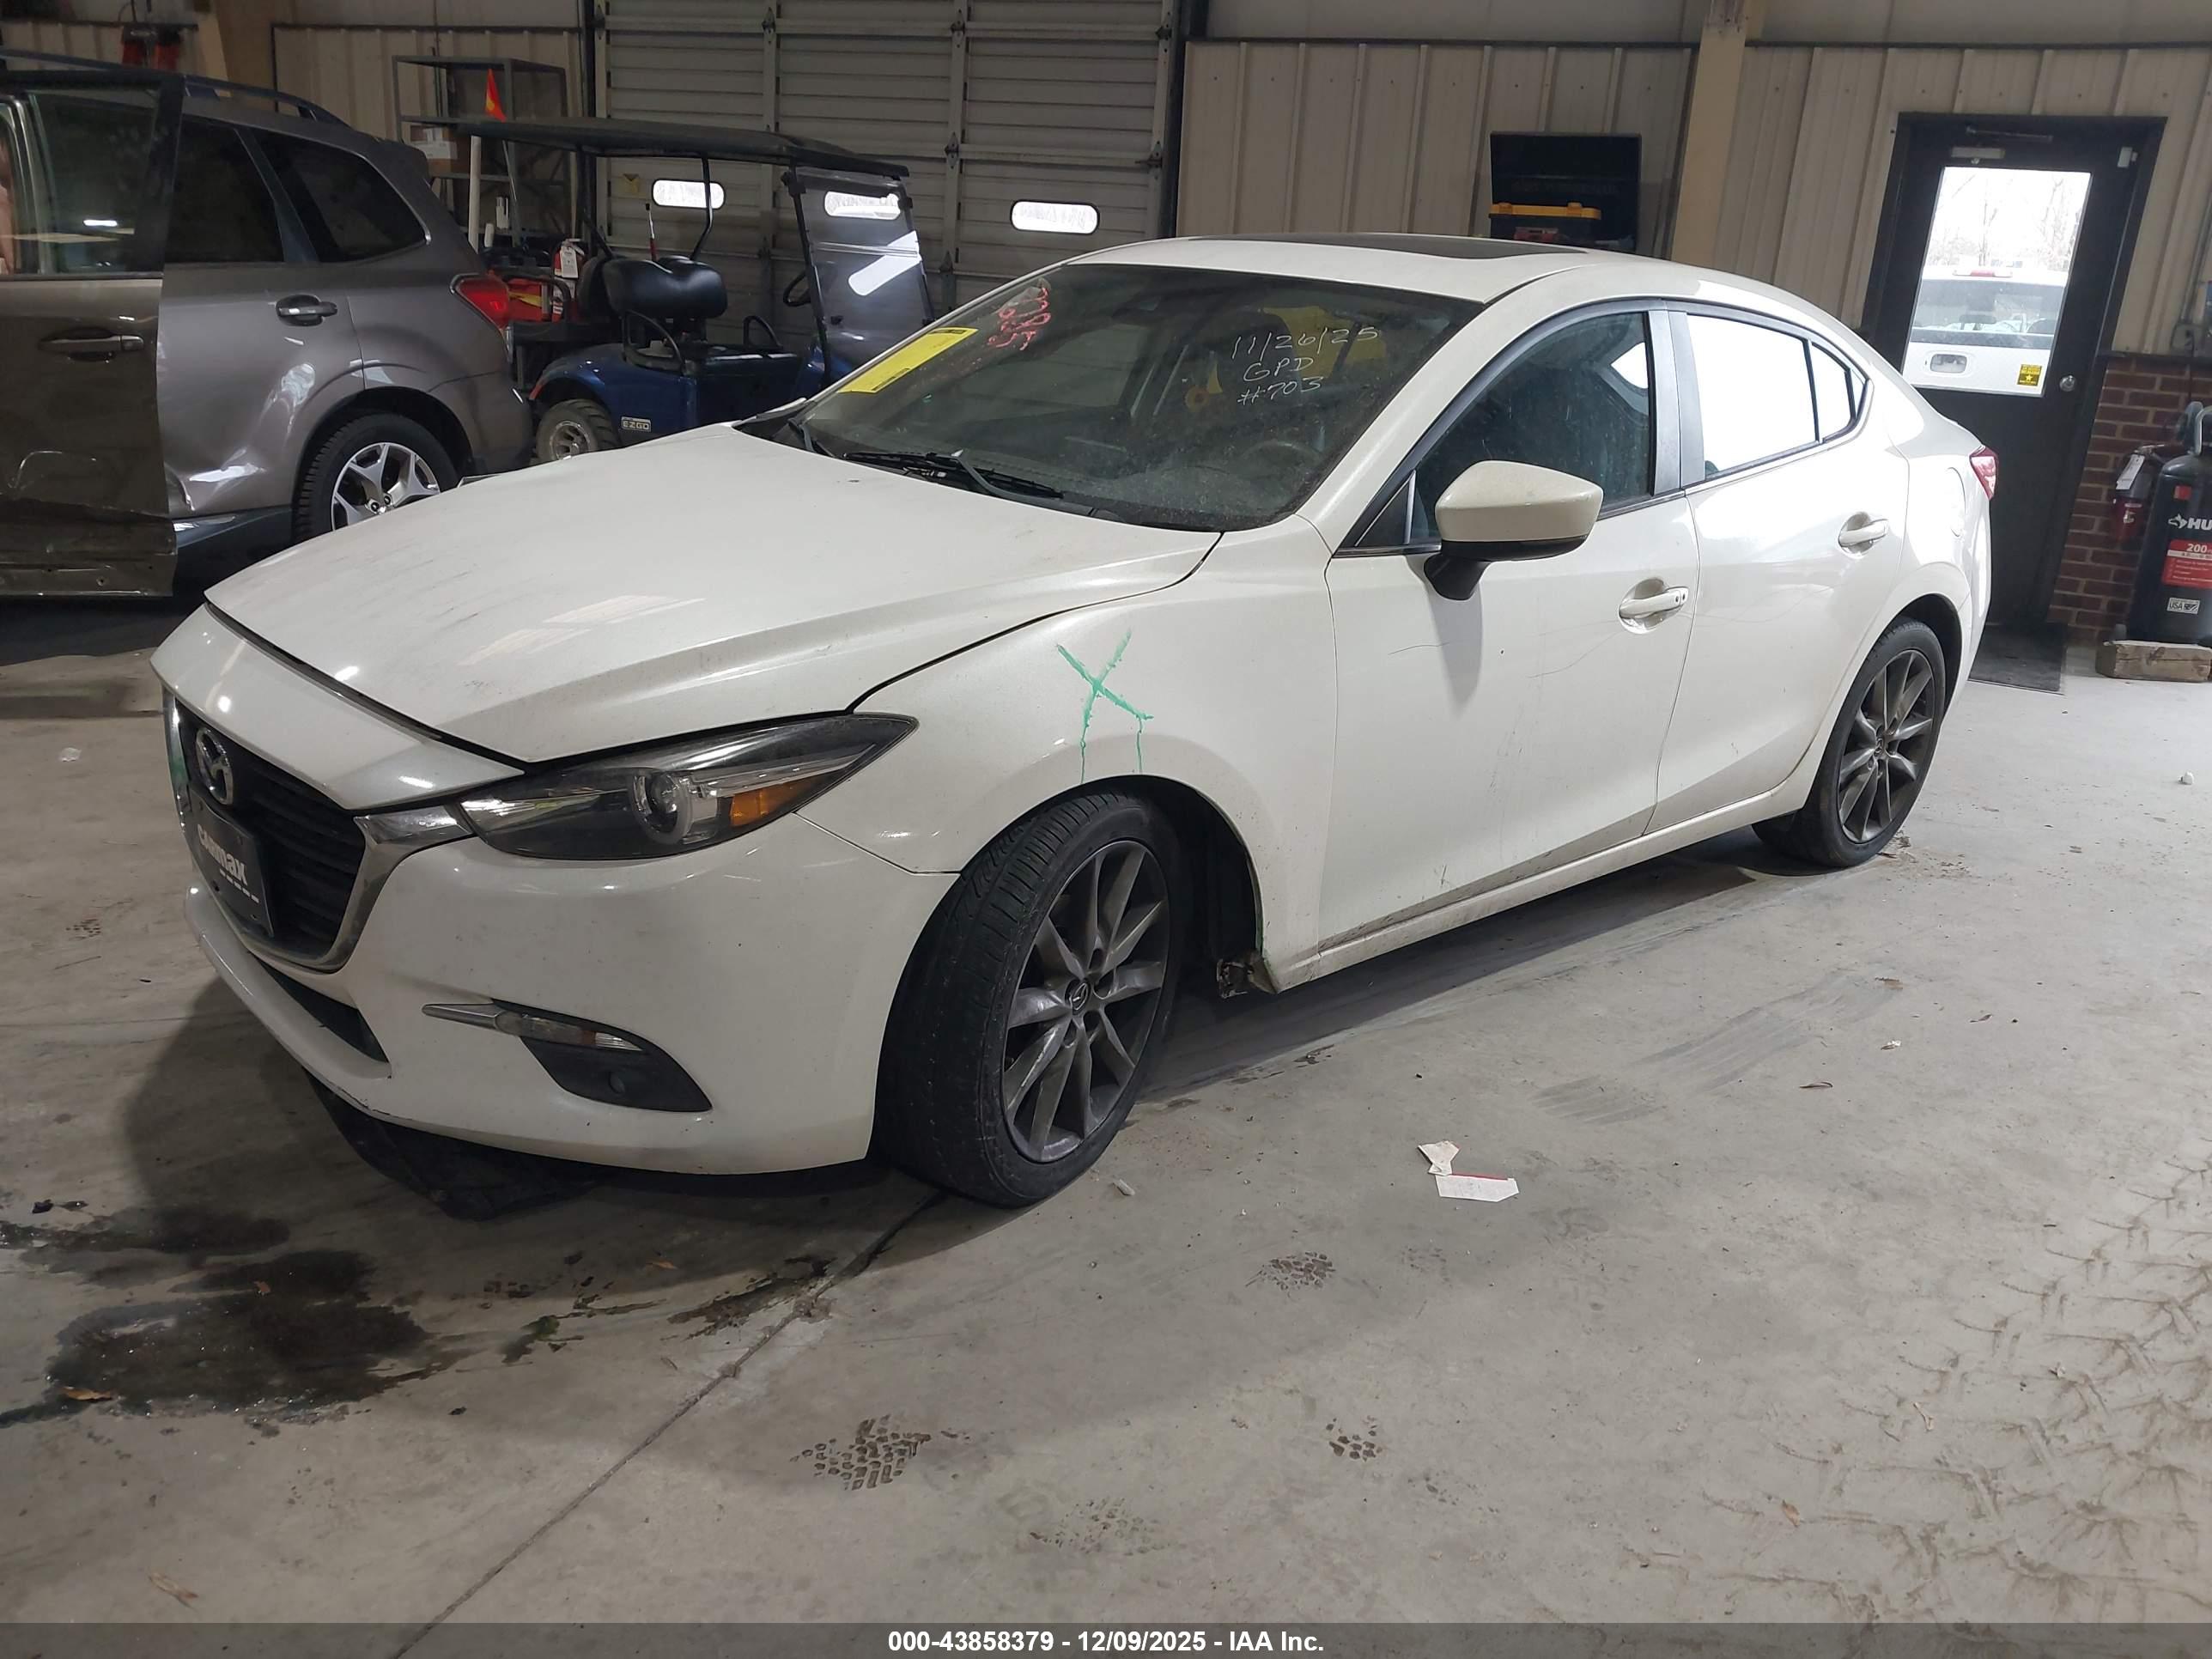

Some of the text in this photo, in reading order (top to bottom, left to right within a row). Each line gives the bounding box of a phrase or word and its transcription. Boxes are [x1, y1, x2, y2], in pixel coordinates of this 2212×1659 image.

[1231, 326, 1378, 362] 11/26/25
[1243, 357, 1314, 381] GPD
[1237, 376, 1324, 405] #703
